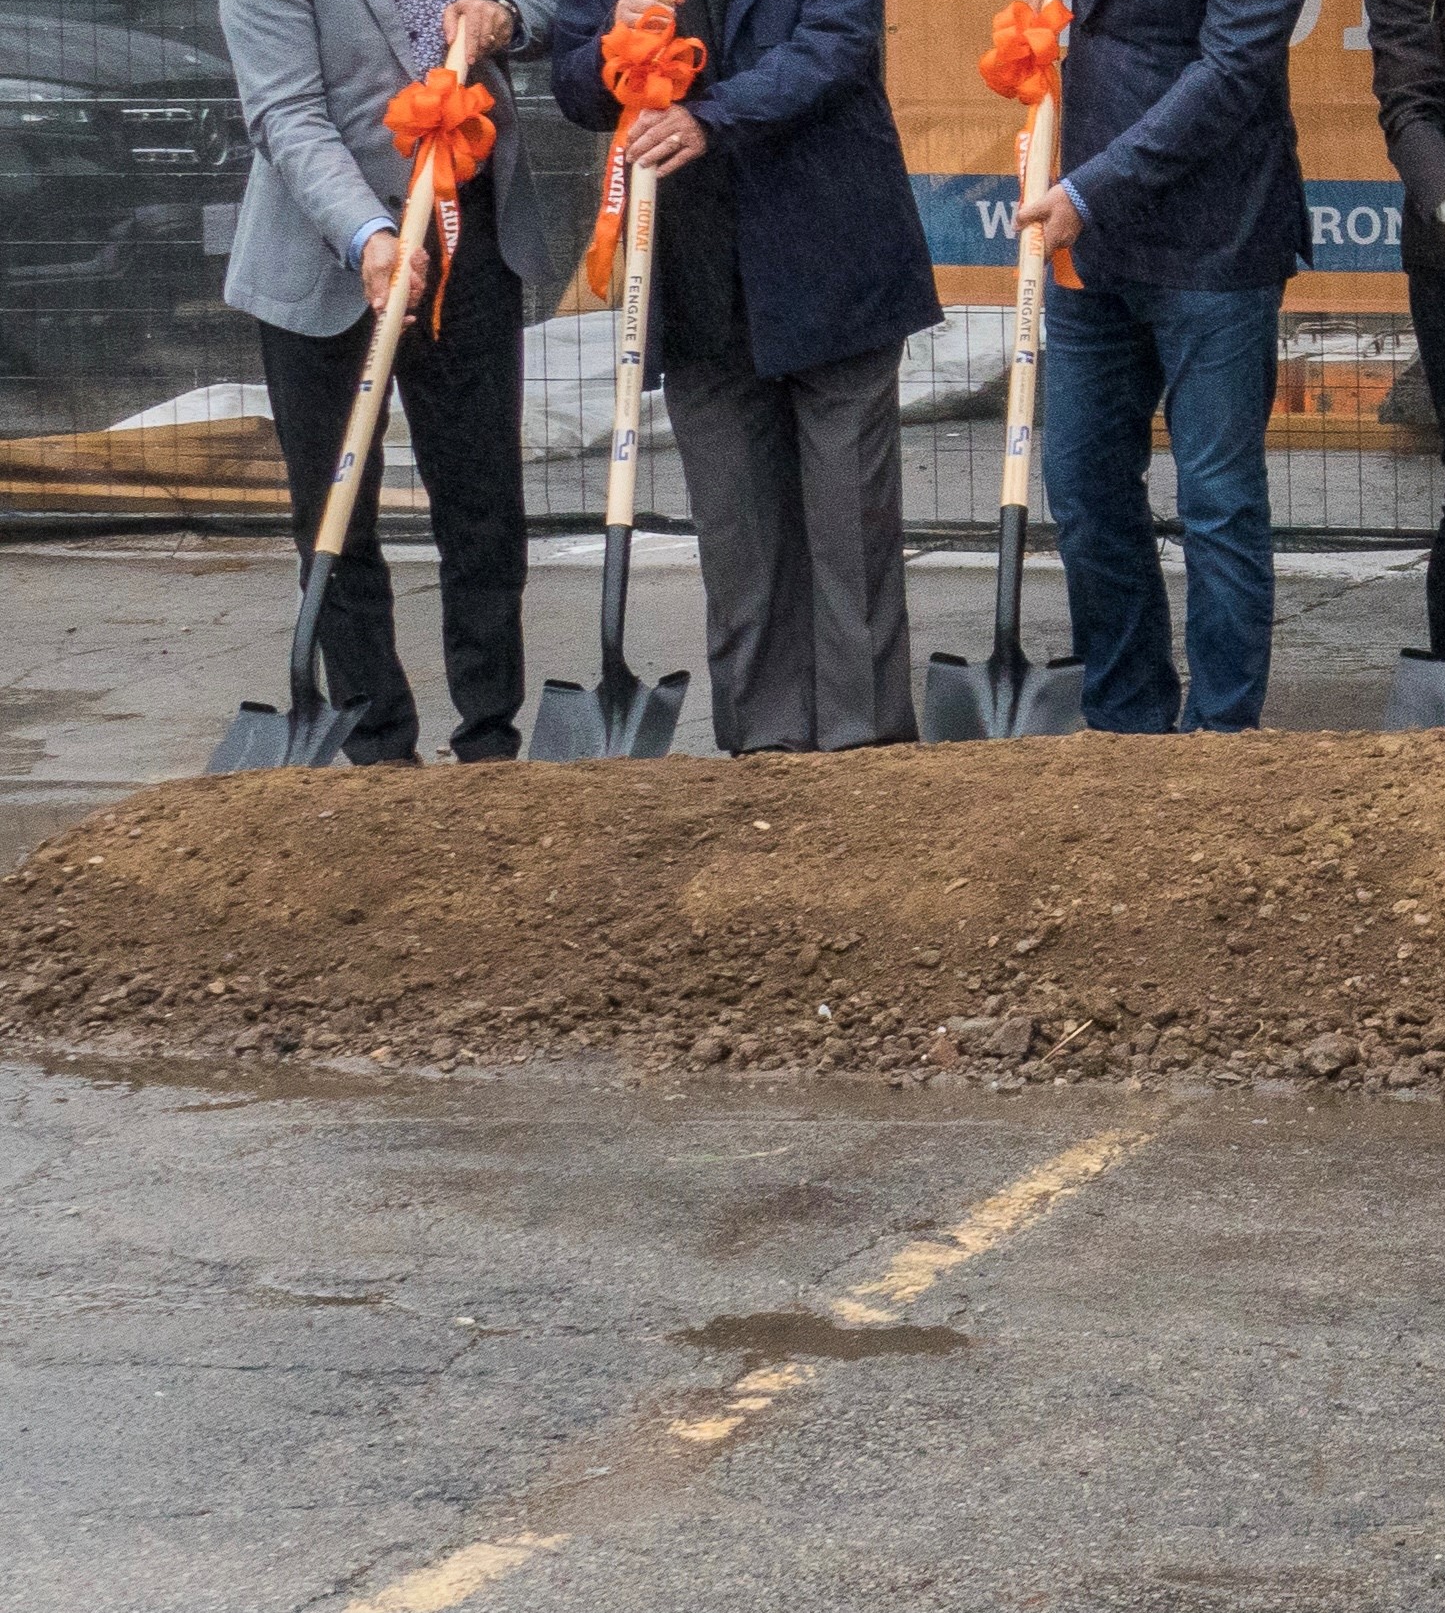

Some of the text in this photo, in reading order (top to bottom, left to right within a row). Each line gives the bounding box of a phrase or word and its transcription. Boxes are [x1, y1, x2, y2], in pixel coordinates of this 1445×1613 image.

[635, 198, 652, 254] LiUNA!
[976, 201, 1020, 239] W
[623, 275, 643, 342] FENGATE
[1018, 278, 1037, 342] FENGATE
